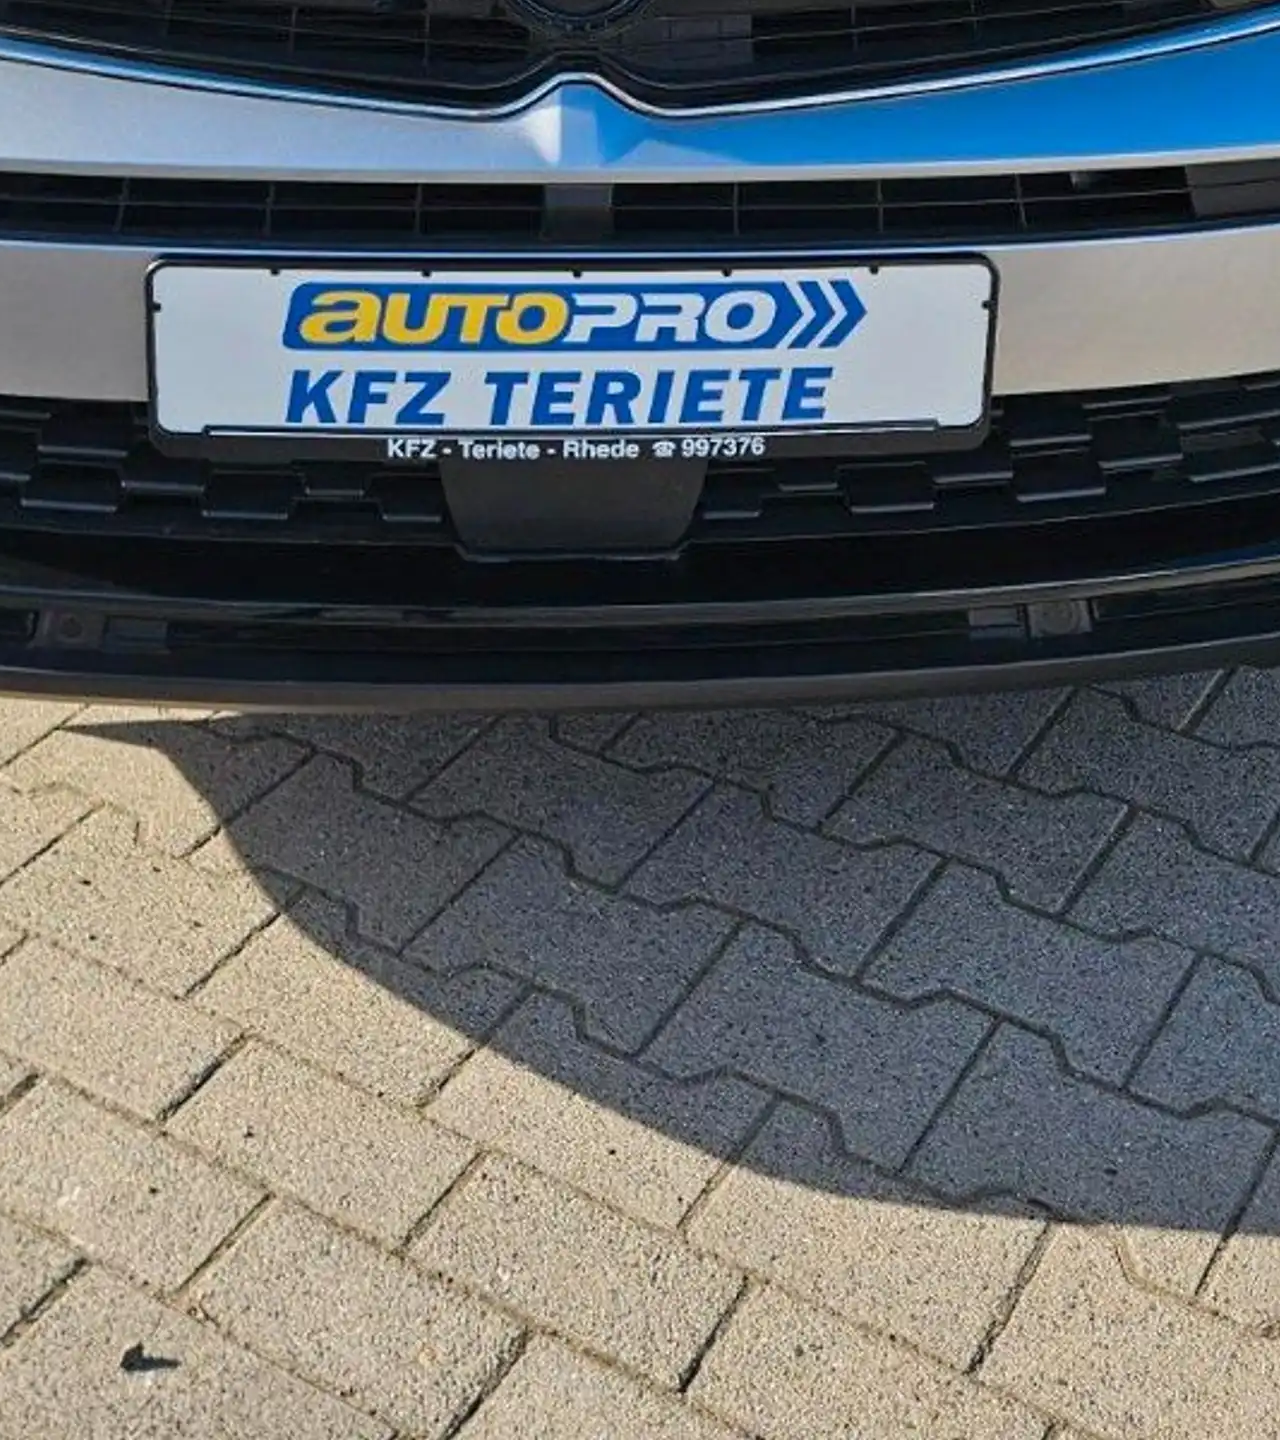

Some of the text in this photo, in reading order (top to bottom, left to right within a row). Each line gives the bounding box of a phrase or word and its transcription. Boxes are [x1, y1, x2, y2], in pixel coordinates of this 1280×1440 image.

[285, 366, 833, 426] KFZ TERIETE
[386, 438, 437, 459] KFZ
[458, 439, 540, 460] Teriete
[563, 439, 639, 459] Rhede
[680, 436, 766, 458] 997376
